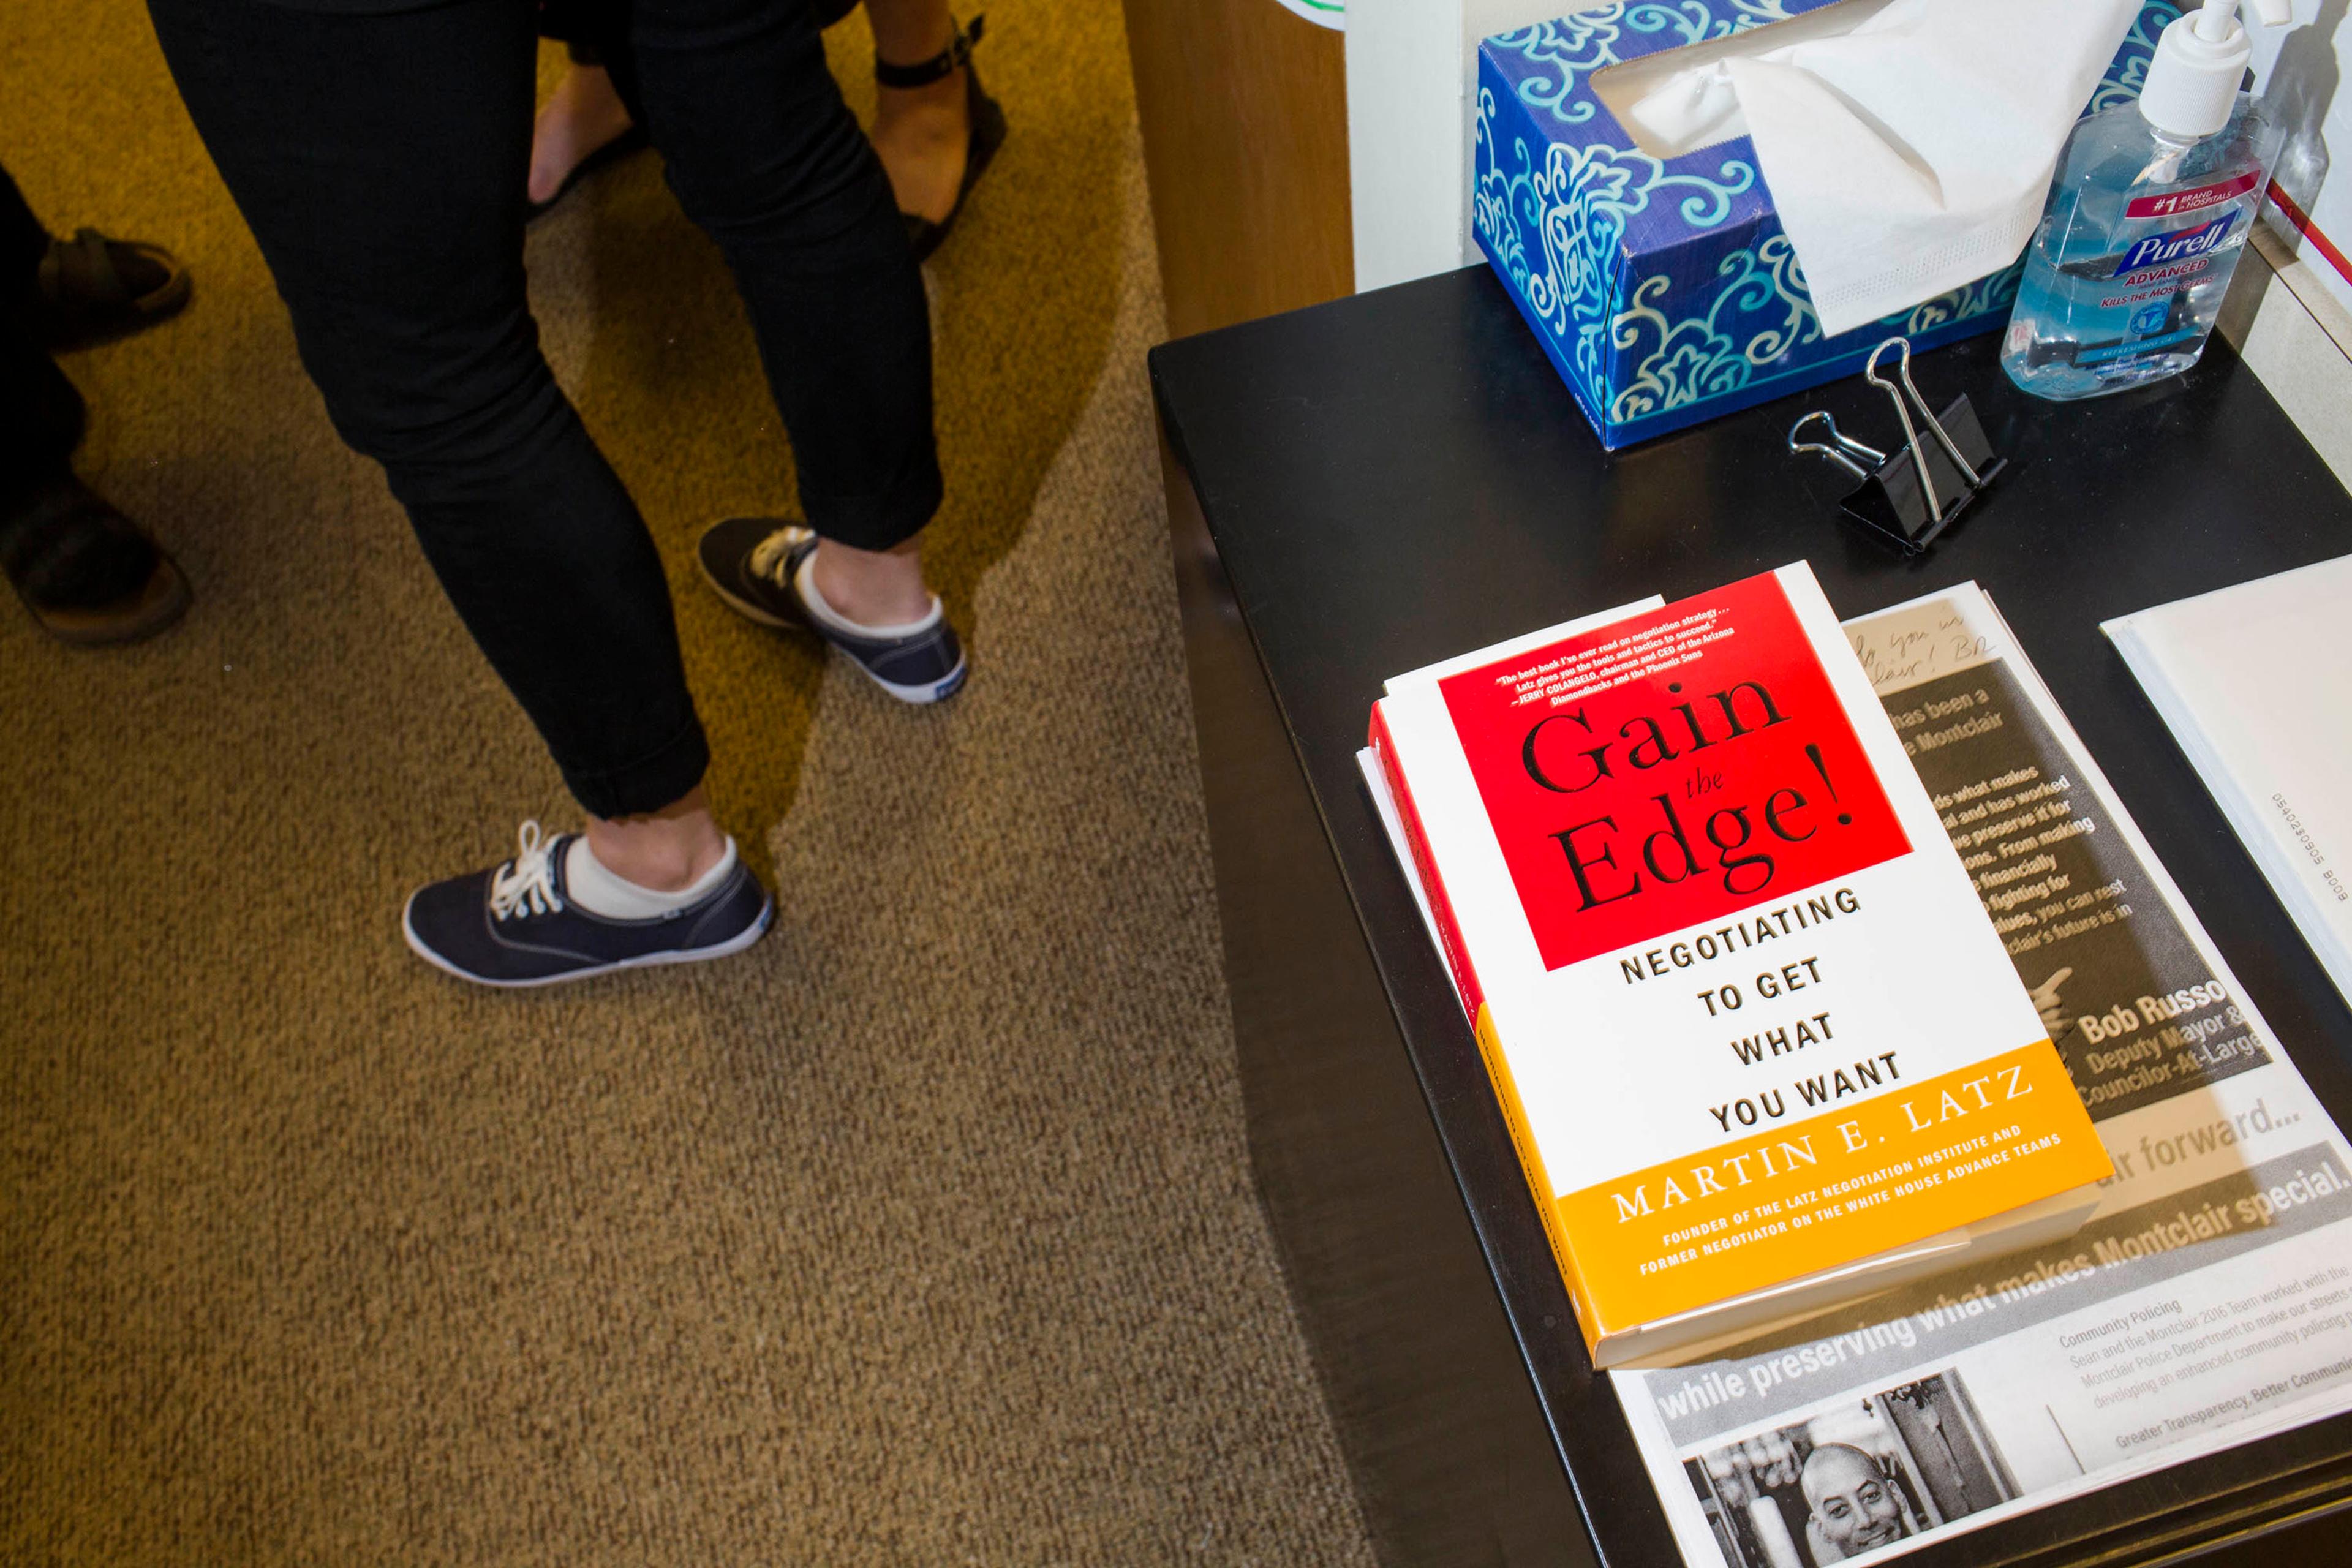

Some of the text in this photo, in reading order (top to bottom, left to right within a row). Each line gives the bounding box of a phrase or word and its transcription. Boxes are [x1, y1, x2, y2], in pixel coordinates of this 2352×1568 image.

[2154, 196, 2178, 213] #1
[2180, 190, 2213, 203] BRAND
[2187, 190, 2233, 209] HOSPITALS
[2124, 258, 2209, 288] ADVANCED
[2131, 222, 2226, 266] Purell
[2101, 296, 2128, 309] KILLS
[2130, 292, 2147, 304] THE
[2149, 285, 2179, 299] MOST
[1516, 679, 1536, 693] Latz
[1536, 671, 1559, 687] gives
[1559, 666, 1577, 679] you
[1576, 661, 1591, 673] the
[1591, 653, 1615, 668] tools
[1615, 647, 1632, 660] and
[1632, 637, 1664, 654] tactics
[1664, 633, 1675, 643] to
[1518, 666, 1537, 680] best
[1537, 659, 1559, 673] book
[1578, 648, 1597, 660] ever
[1597, 639, 1618, 654] read
[1619, 637, 1630, 646] on
[1631, 619, 1681, 643] negotiation
[1545, 669, 1600, 696] COLANGELO,
[1599, 657, 1640, 677] chairman
[1639, 651, 1657, 663] and
[1656, 644, 1676, 658] CEO
[1675, 641, 1687, 652] of
[1686, 636, 1701, 647] the
[1702, 625, 1735, 643] Arizona
[1549, 647, 1703, 707] Diamondbacks and the Phoenix Suns
[1914, 710, 2004, 753] Montclair
[1924, 693, 1975, 722] been
[1974, 688, 1990, 704] a
[1521, 681, 1792, 794] Gain
[1686, 767, 1724, 799] the
[1950, 779, 1992, 803] what
[1988, 763, 2040, 790] makes
[1955, 802, 1988, 824] and
[1985, 793, 2016, 814] has
[2013, 775, 2071, 805] worked
[1548, 743, 1853, 914] Edge!
[1970, 812, 2039, 846] preserve
[2032, 804, 2051, 822] it
[2046, 797, 2073, 818] for
[1996, 815, 2097, 858] From making
[1978, 851, 2060, 892] financially
[1987, 878, 2051, 913] fighting
[2045, 872, 2074, 892] for
[2035, 900, 2068, 922] you
[2065, 892, 2095, 910] can
[2090, 878, 2127, 901] rest
[1613, 888, 1861, 984] NEGOTIATING
[2050, 913, 2100, 940] future
[2097, 907, 2116, 924] is
[2113, 901, 2133, 918] in
[1697, 956, 1821, 1017] TO GET
[2077, 978, 2227, 1045] Bob Russo
[1730, 1012, 1833, 1066] WHAT
[2076, 1030, 2263, 1107] Councilor-At-Large
[2084, 1005, 2245, 1076] Deputy Mayor &
[1709, 1051, 1900, 1133] YOU WANT
[1610, 1065, 2033, 1223] MARTIN E. LATZ
[2139, 1098, 2301, 1171] forward...
[1640, 1133, 2061, 1275] FORMER NEGOTIATOR ON THE WHITE HOUSE ADVANCE TEAMS
[1662, 1125, 2021, 1246] FOUNDER OF THE LATZ NEGOTIATION INSTITUTE AND
[1659, 1162, 2351, 1417] while preserving what makes Montclair special.
[2069, 1264, 2349, 1368] Sean and the Montclair 2016 Team worked with the
[2058, 1297, 2182, 1350] Community Policing
[2080, 1288, 2349, 1388] Montclair Police Department to make our streets
[2092, 1378, 2158, 1411] developing
[2157, 1373, 2176, 1385] an
[2173, 1351, 2233, 1380] enhanced
[2232, 1328, 2301, 1362] community
[2297, 1312, 2347, 1340] policing
[2115, 1423, 2165, 1449] Greater
[2164, 1393, 2252, 1433] Transparency,
[2250, 1378, 2291, 1402] Better
